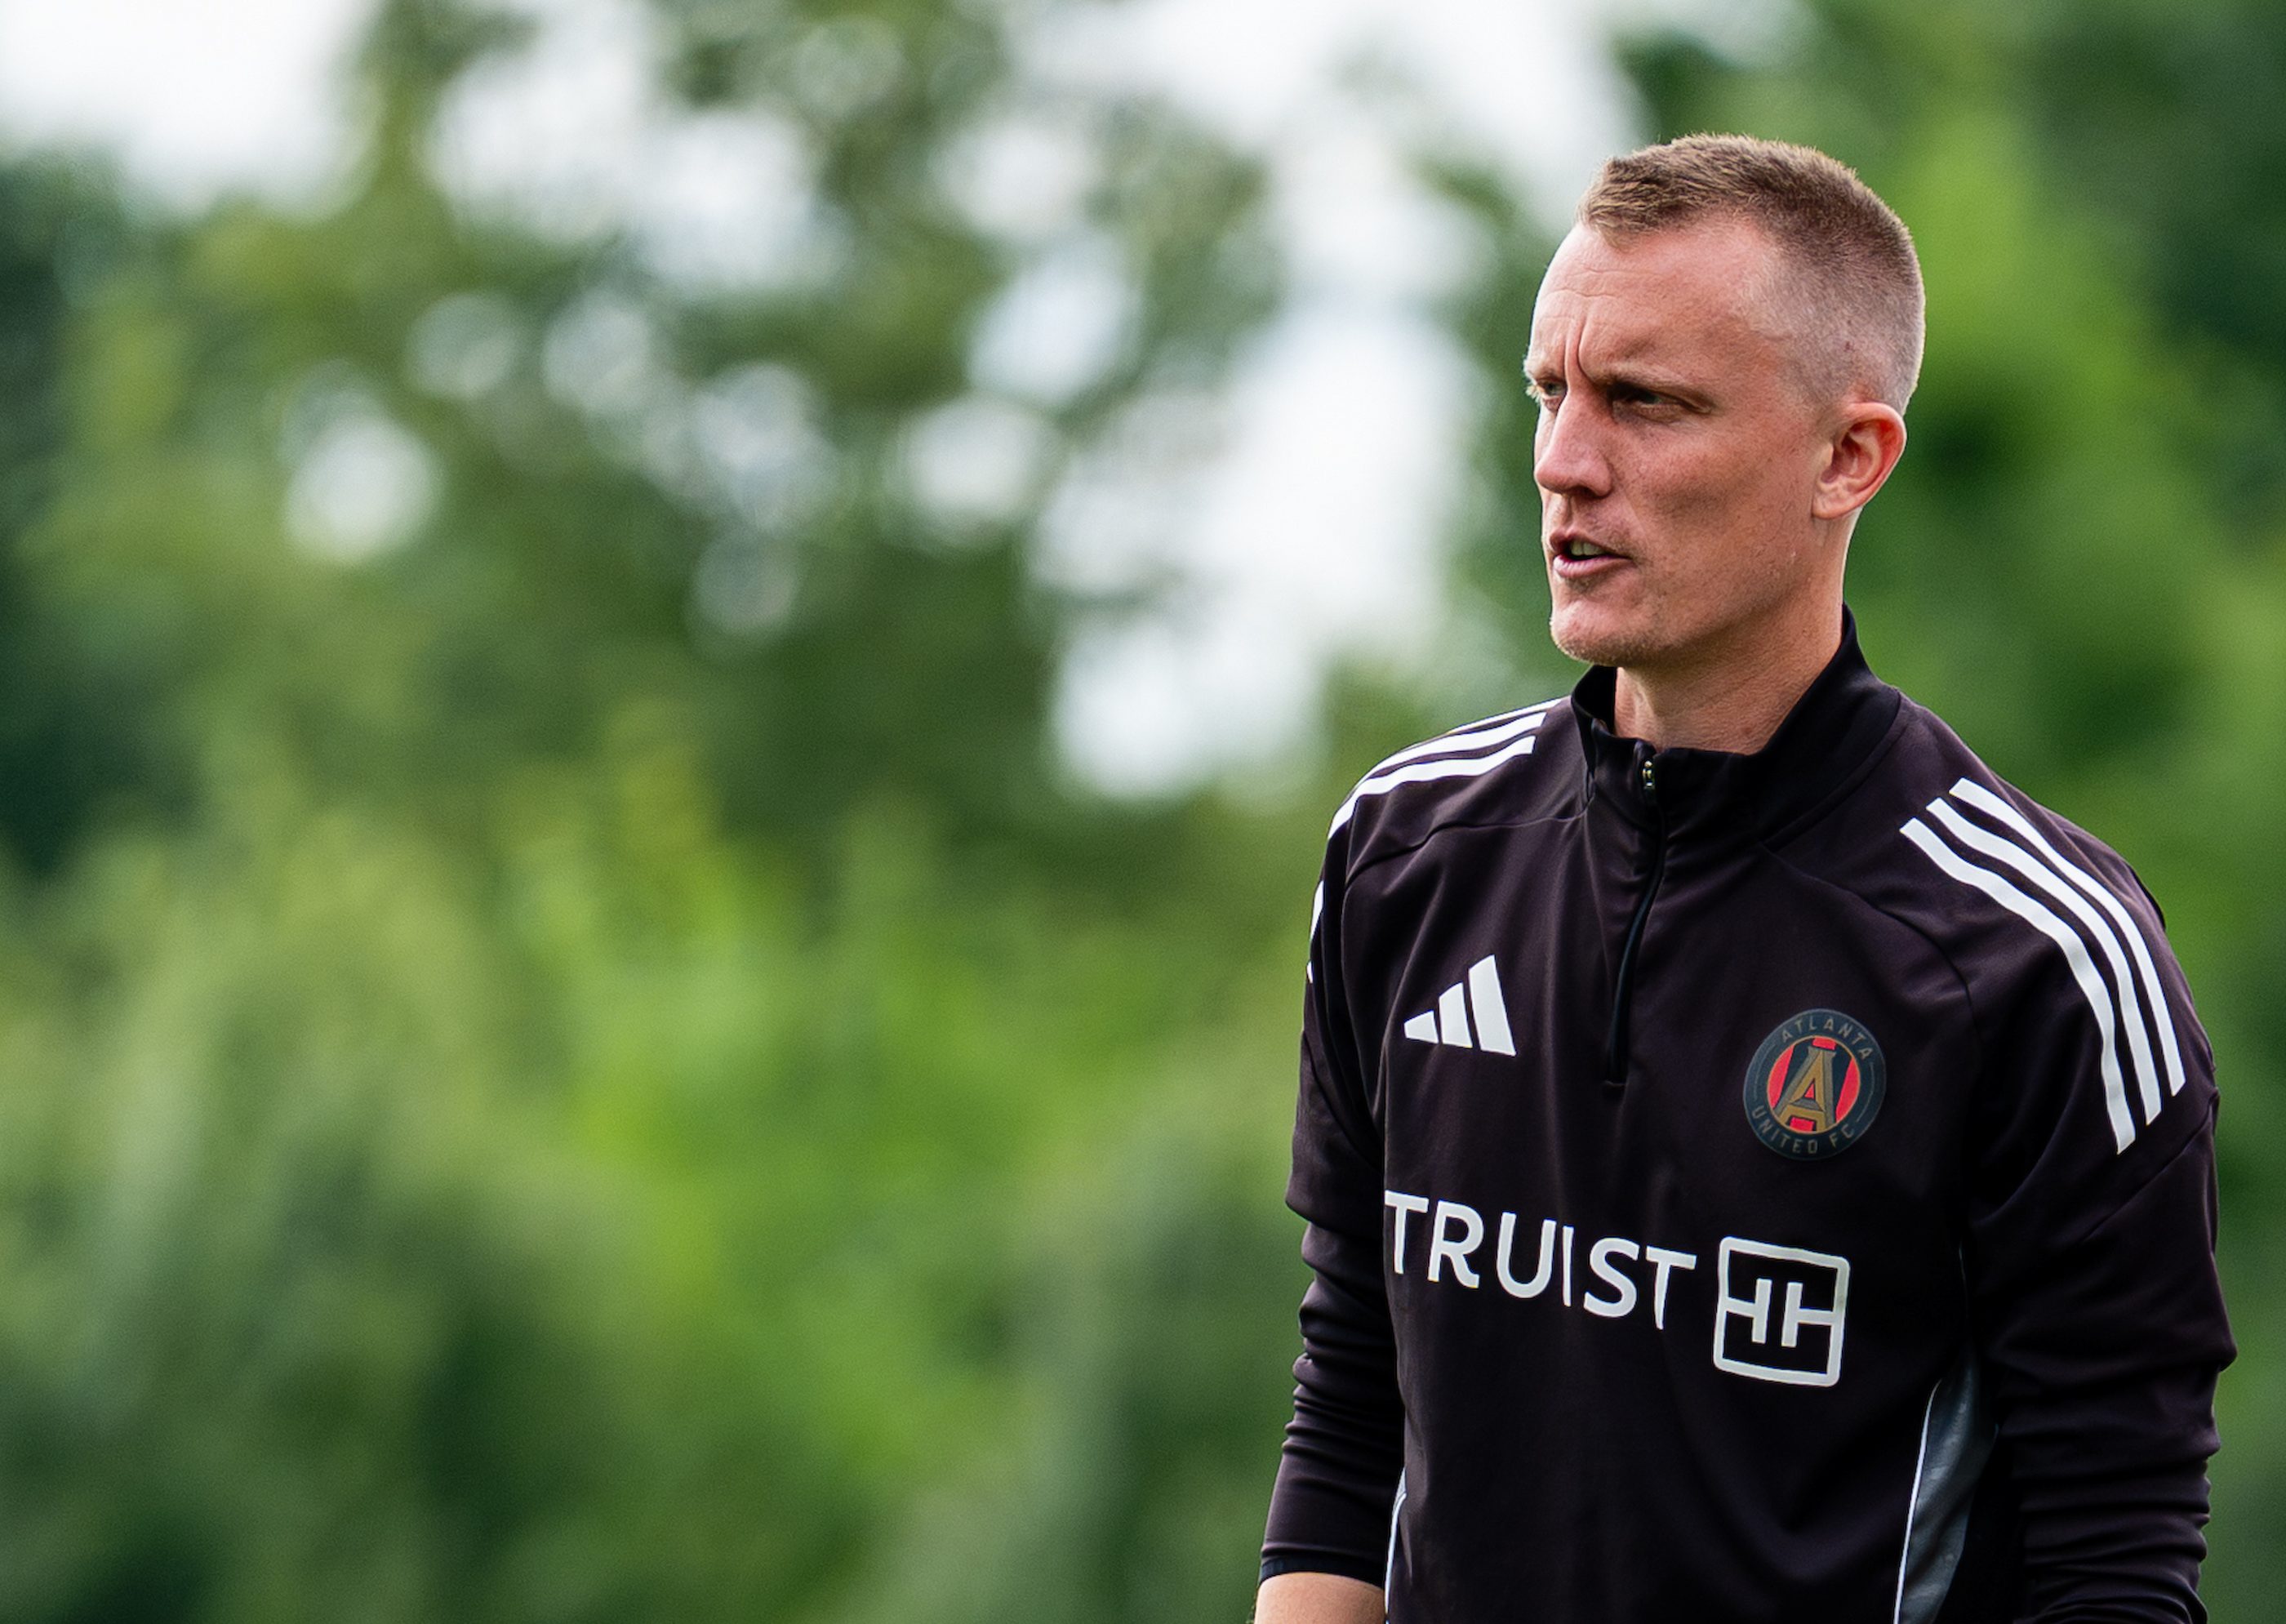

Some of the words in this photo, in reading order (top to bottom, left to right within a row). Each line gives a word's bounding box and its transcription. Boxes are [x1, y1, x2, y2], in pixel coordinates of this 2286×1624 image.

[1781, 1017, 1873, 1060] ATLANTA
[1753, 1106, 1817, 1153] UNITED
[1830, 1123, 1854, 1147] FC
[1385, 1190, 1697, 1329] TRUIST
